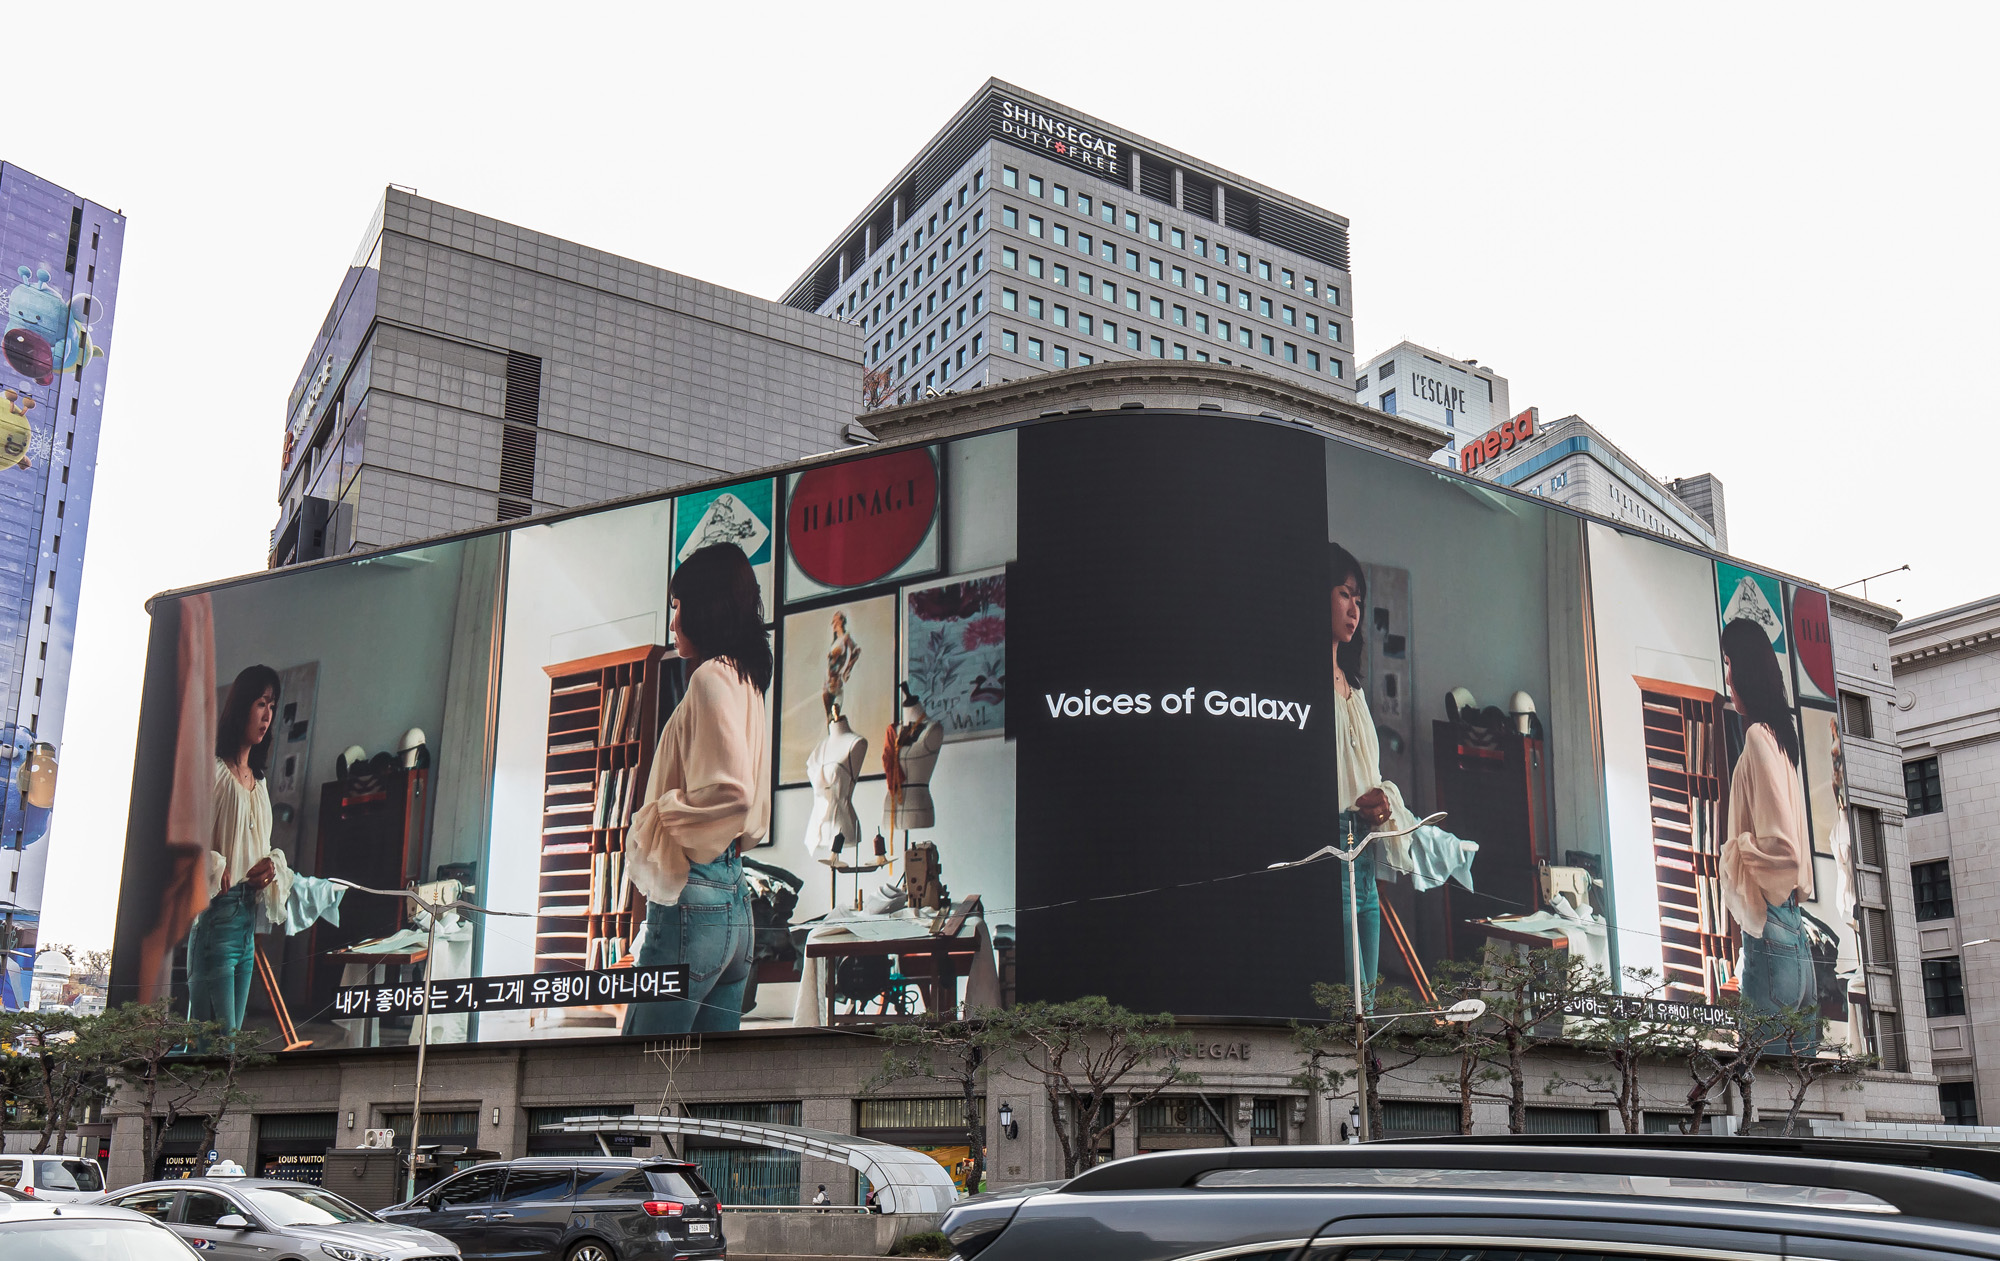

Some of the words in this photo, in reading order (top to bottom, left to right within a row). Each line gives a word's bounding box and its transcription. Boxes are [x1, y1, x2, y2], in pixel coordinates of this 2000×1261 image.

[1002, 101, 1117, 159] SHINSEGAE
[1002, 120, 1052, 149] DUTY
[1069, 145, 1118, 175] FREE
[1411, 371, 1466, 414] L'ESCAPE
[1460, 409, 1534, 473] mesa
[1045, 688, 1152, 718] Voices
[1160, 686, 1195, 715] of
[1204, 690, 1312, 730] Galaxy
[335, 989, 371, 1014] 내가
[375, 985, 449, 1012] 좋아하는
[454, 983, 478, 1009] 거,
[485, 979, 525, 1005] 그게
[530, 975, 591, 1003] 유행이
[598, 971, 681, 999] 아니어도
[1657, 1003, 1690, 1021] 유행이
[166, 1157, 184, 1165] LOUIS
[278, 1155, 298, 1164] LOUIS
